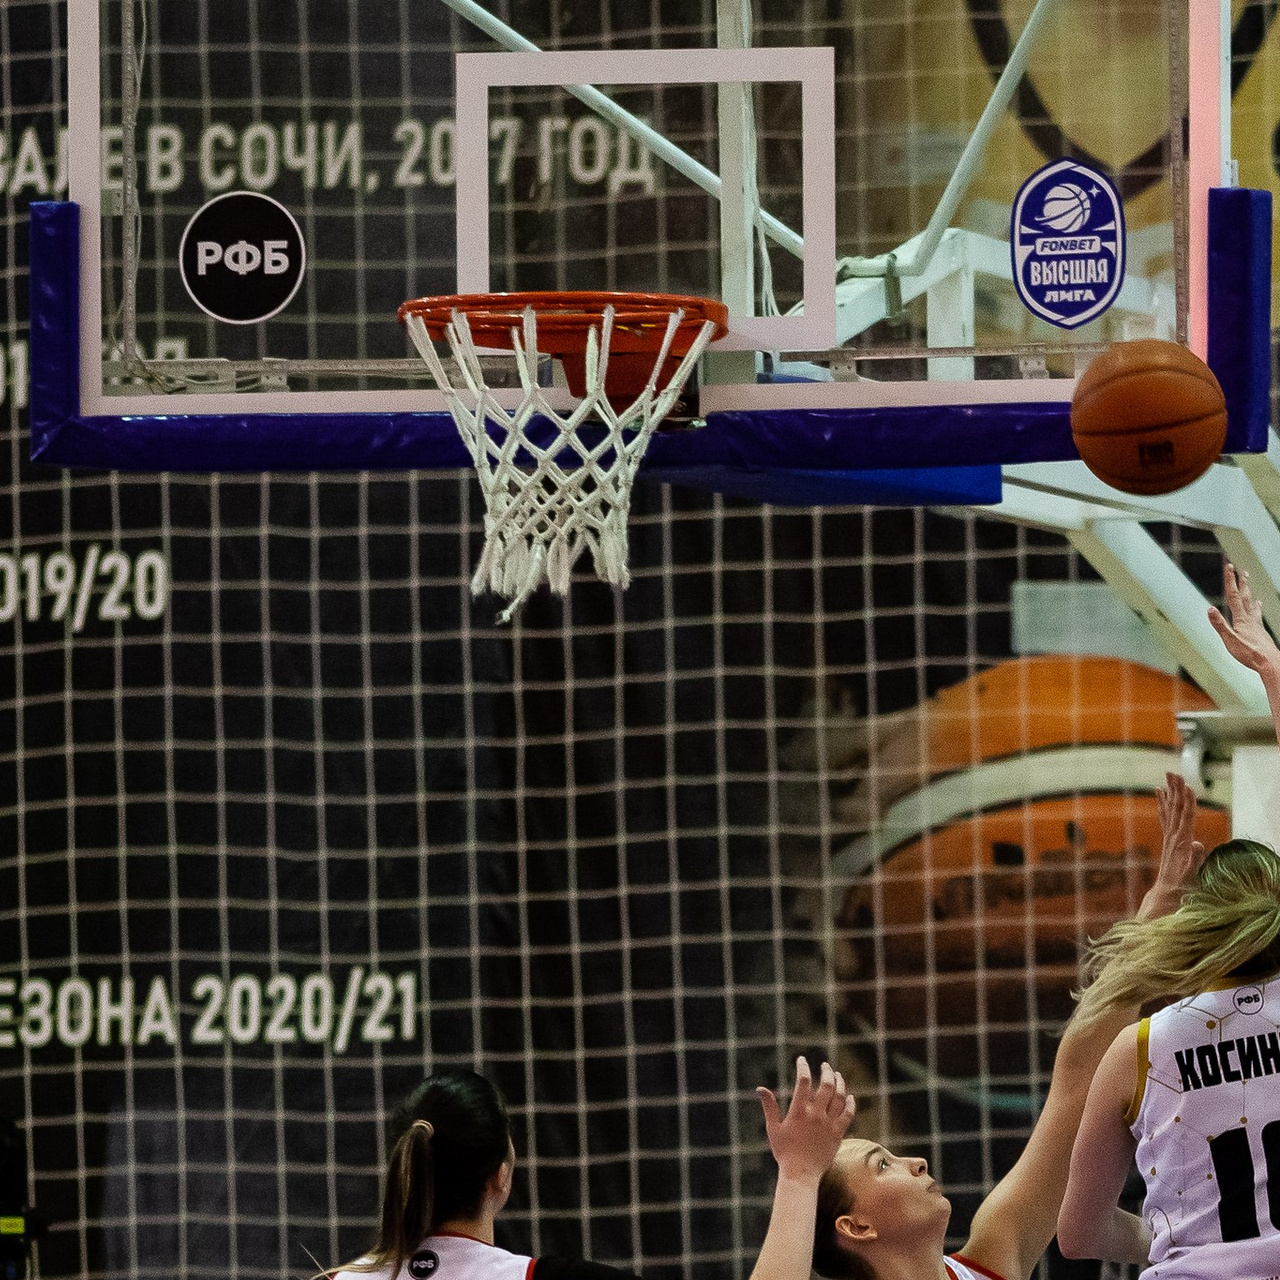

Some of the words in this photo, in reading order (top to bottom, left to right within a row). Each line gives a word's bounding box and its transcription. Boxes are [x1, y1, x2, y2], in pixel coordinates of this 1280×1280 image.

[149, 125, 184, 191] В
[199, 118, 379, 193] СОЧИ,
[394, 116, 520, 187] 207
[538, 115, 657, 196] ГОД
[197, 240, 290, 275] РФБ
[1040, 238, 1096, 252] FONBET
[1030, 258, 1109, 286] ВЫСШАЯ
[1044, 288, 1097, 303] ЛИГА
[192, 965, 417, 1054] 2020/21
[1237, 993, 1261, 1007] РФБ
